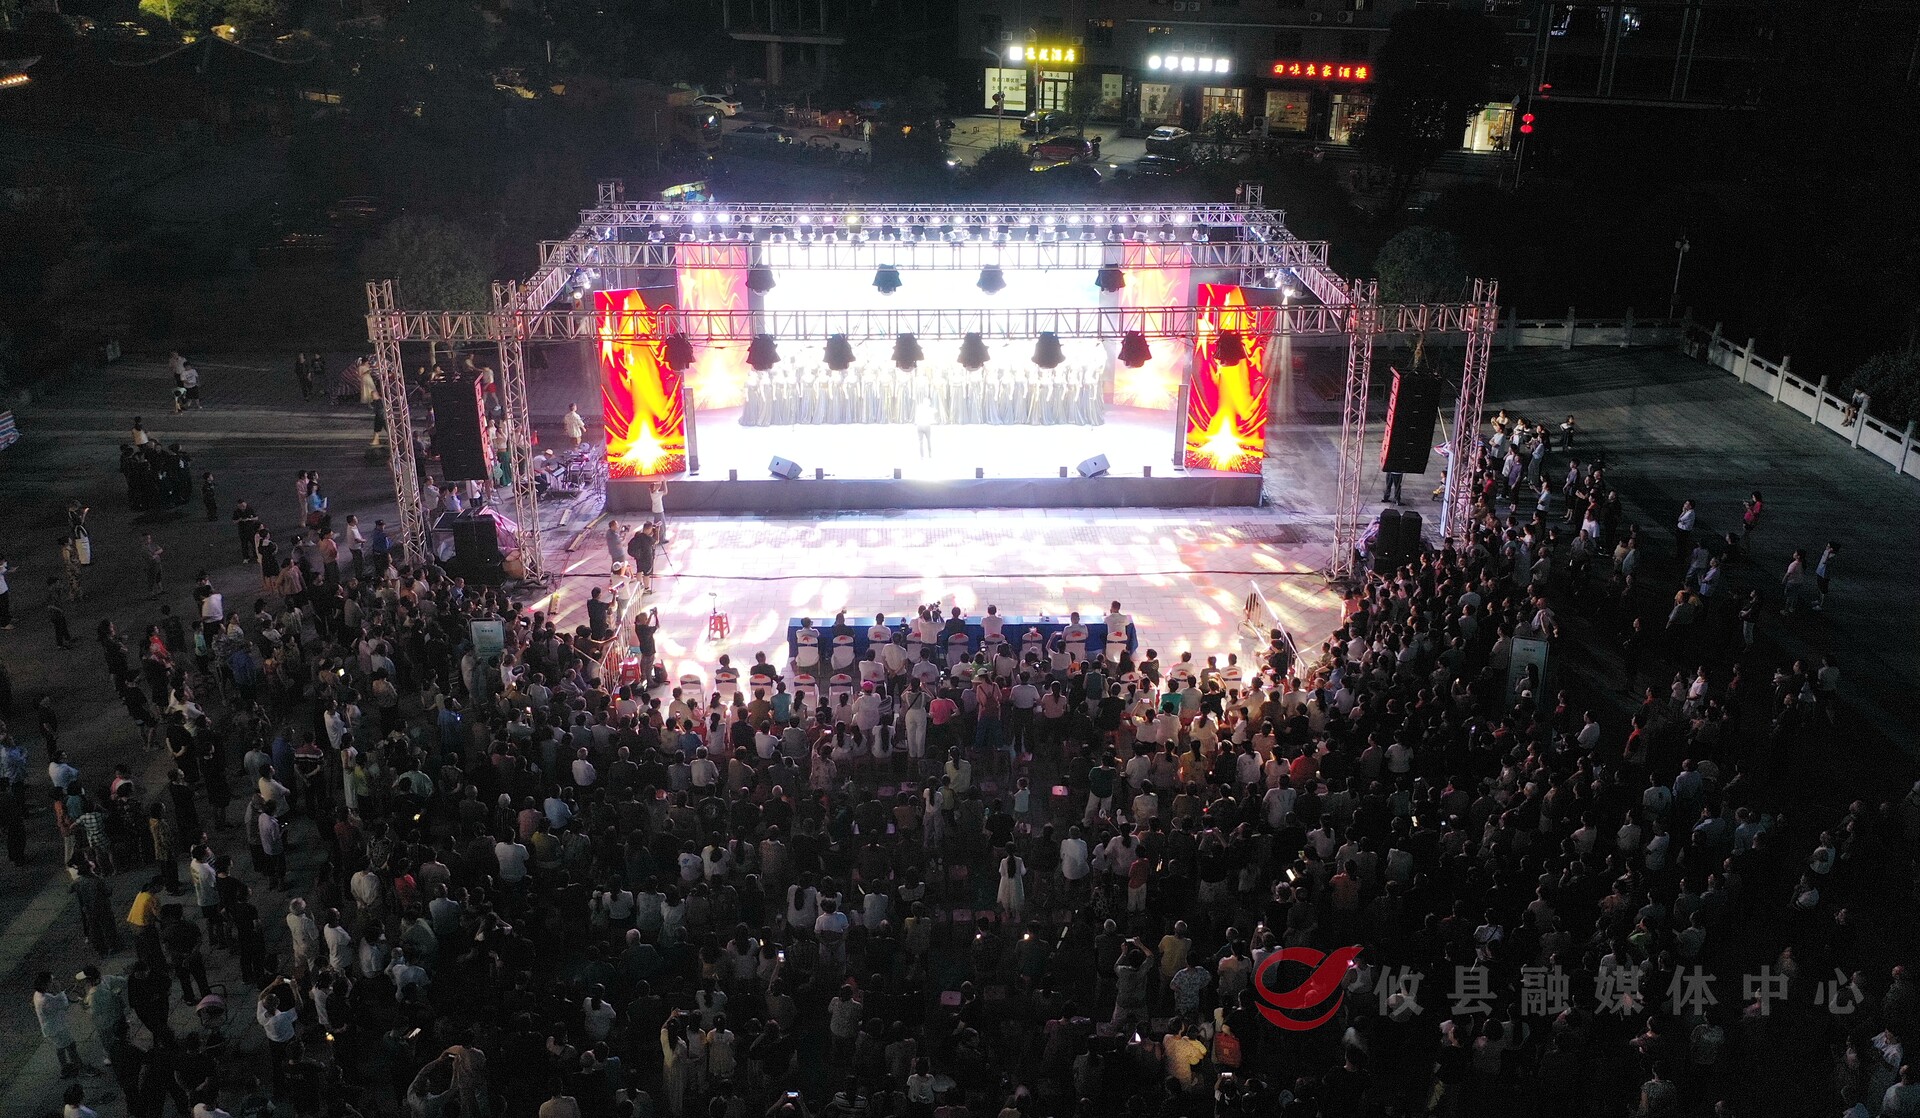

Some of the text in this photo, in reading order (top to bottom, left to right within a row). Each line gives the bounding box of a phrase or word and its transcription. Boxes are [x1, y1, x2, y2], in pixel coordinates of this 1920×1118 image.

[1274, 63, 1367, 79] 回味农家酒楼
